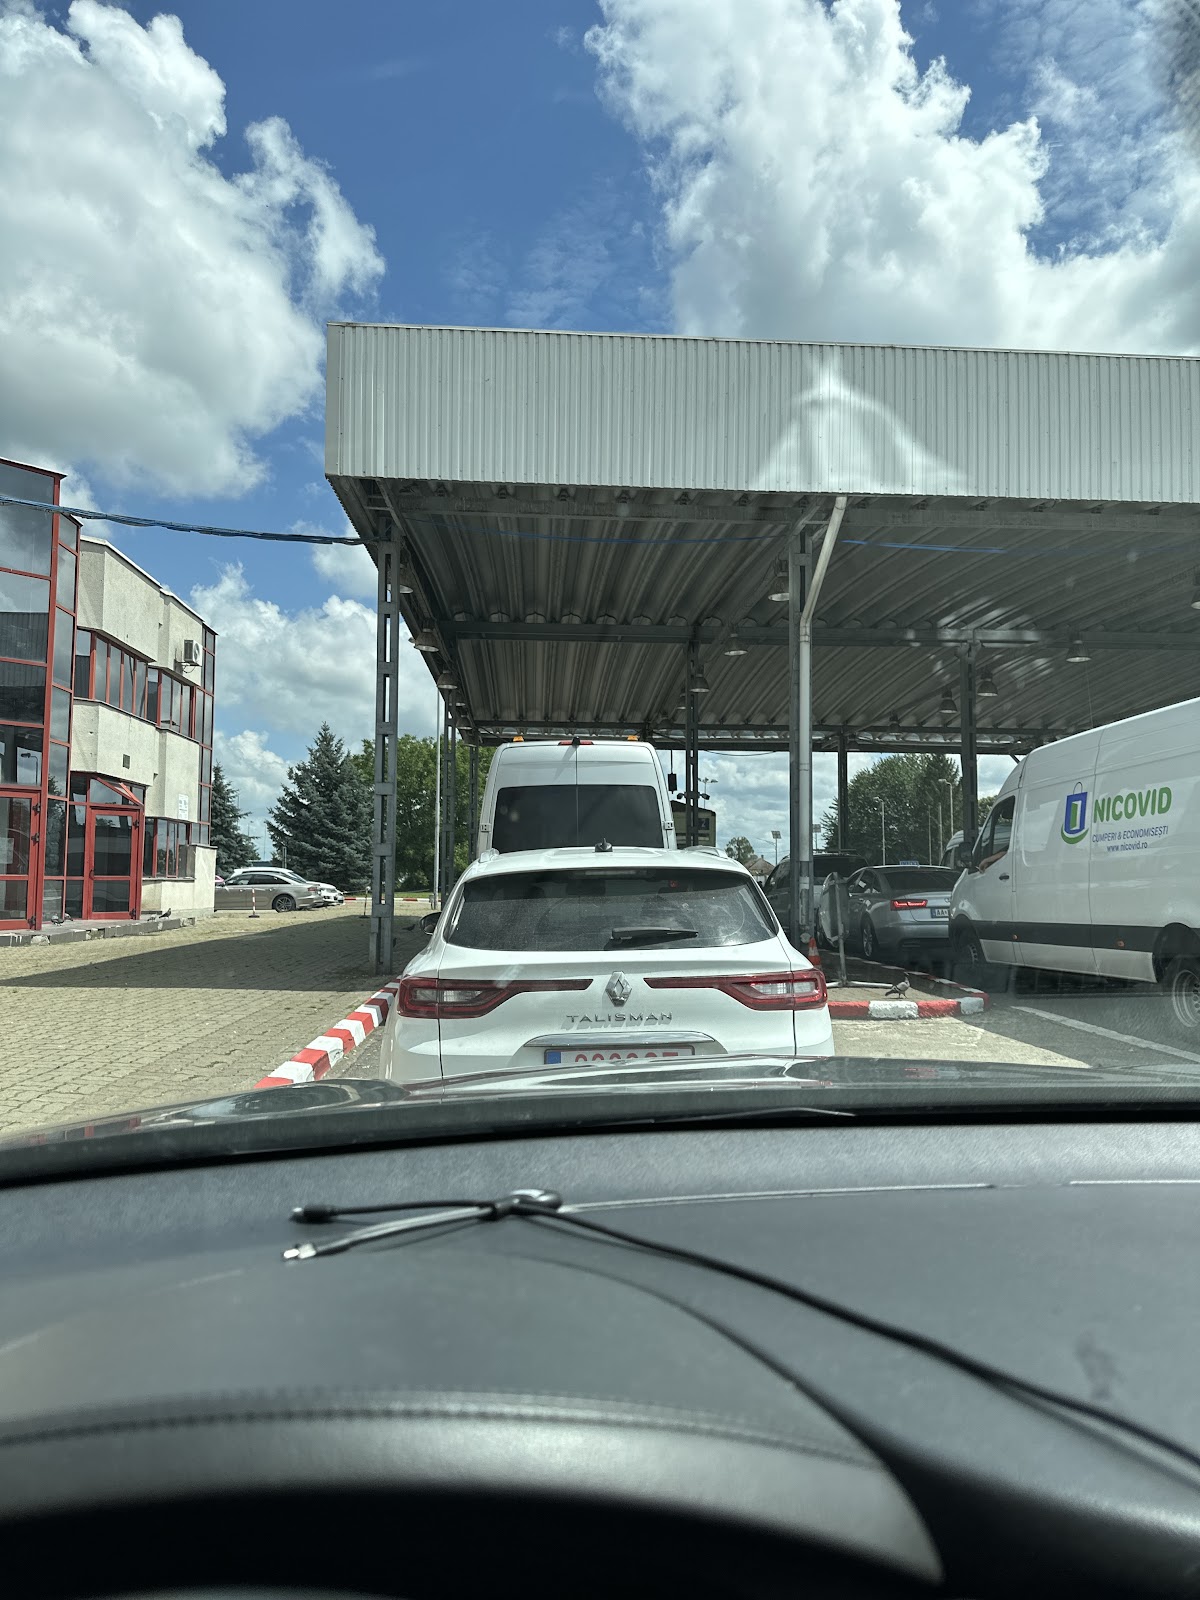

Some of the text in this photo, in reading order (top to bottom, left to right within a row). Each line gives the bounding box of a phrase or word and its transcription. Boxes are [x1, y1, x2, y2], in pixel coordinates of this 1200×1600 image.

[1093, 787, 1172, 824] NICOVID
[1092, 832, 1117, 843] CUMPERI
[1118, 831, 1122, 840] &
[1107, 842, 1148, 852] www.nicovid.ro
[566, 1011, 672, 1023] TALISMAN
